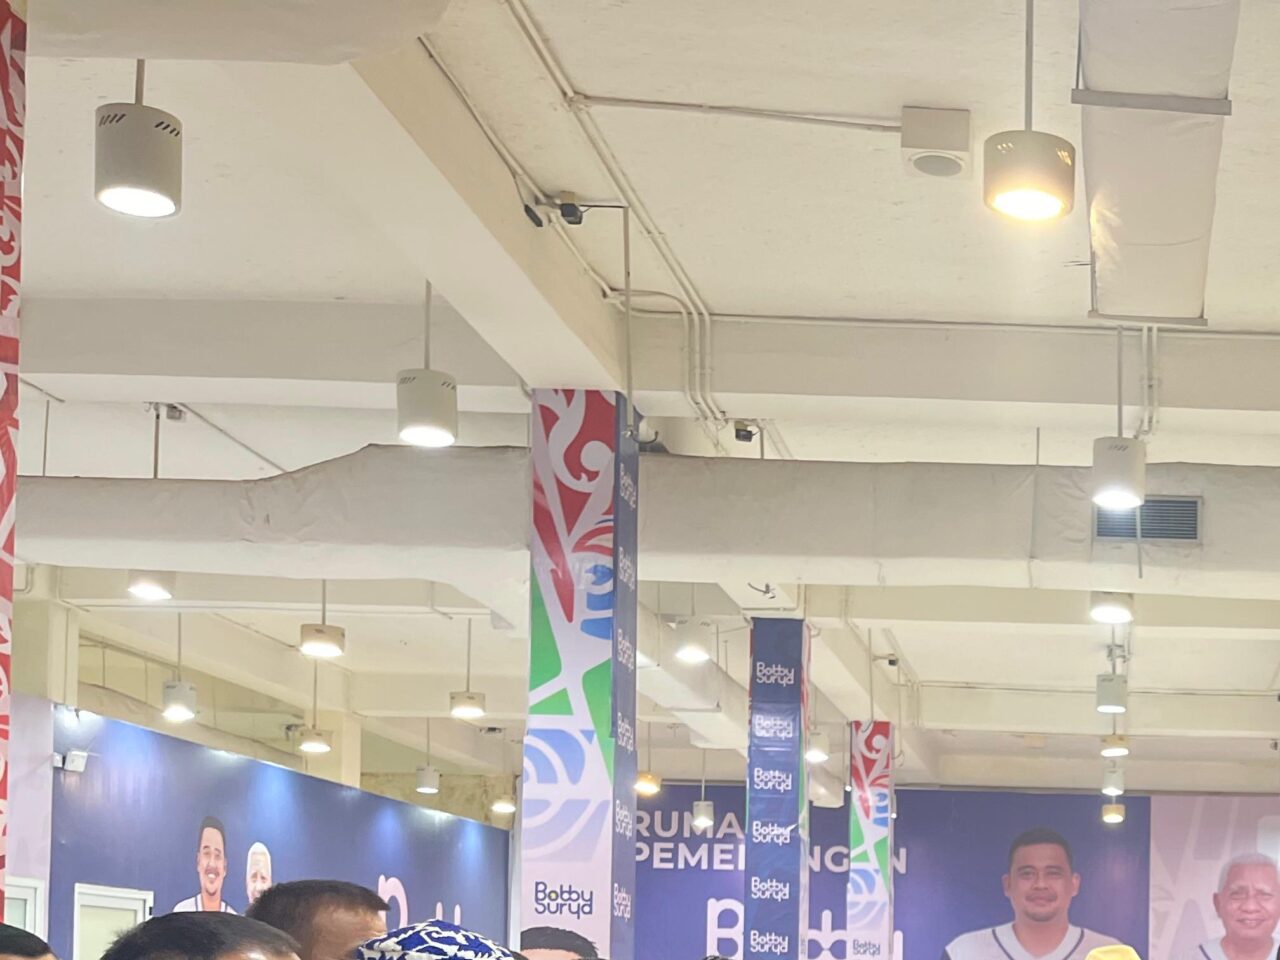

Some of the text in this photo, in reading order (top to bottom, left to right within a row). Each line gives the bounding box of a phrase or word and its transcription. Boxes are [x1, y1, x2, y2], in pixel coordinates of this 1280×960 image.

[756, 662, 795, 677] Bobby
[754, 768, 792, 782] Bobby
[636, 810, 745, 839] RUMA
[752, 821, 791, 835] Bobby
[535, 881, 593, 902] Bobby
[751, 876, 789, 892] Bobby
[750, 930, 788, 945] Bobby
